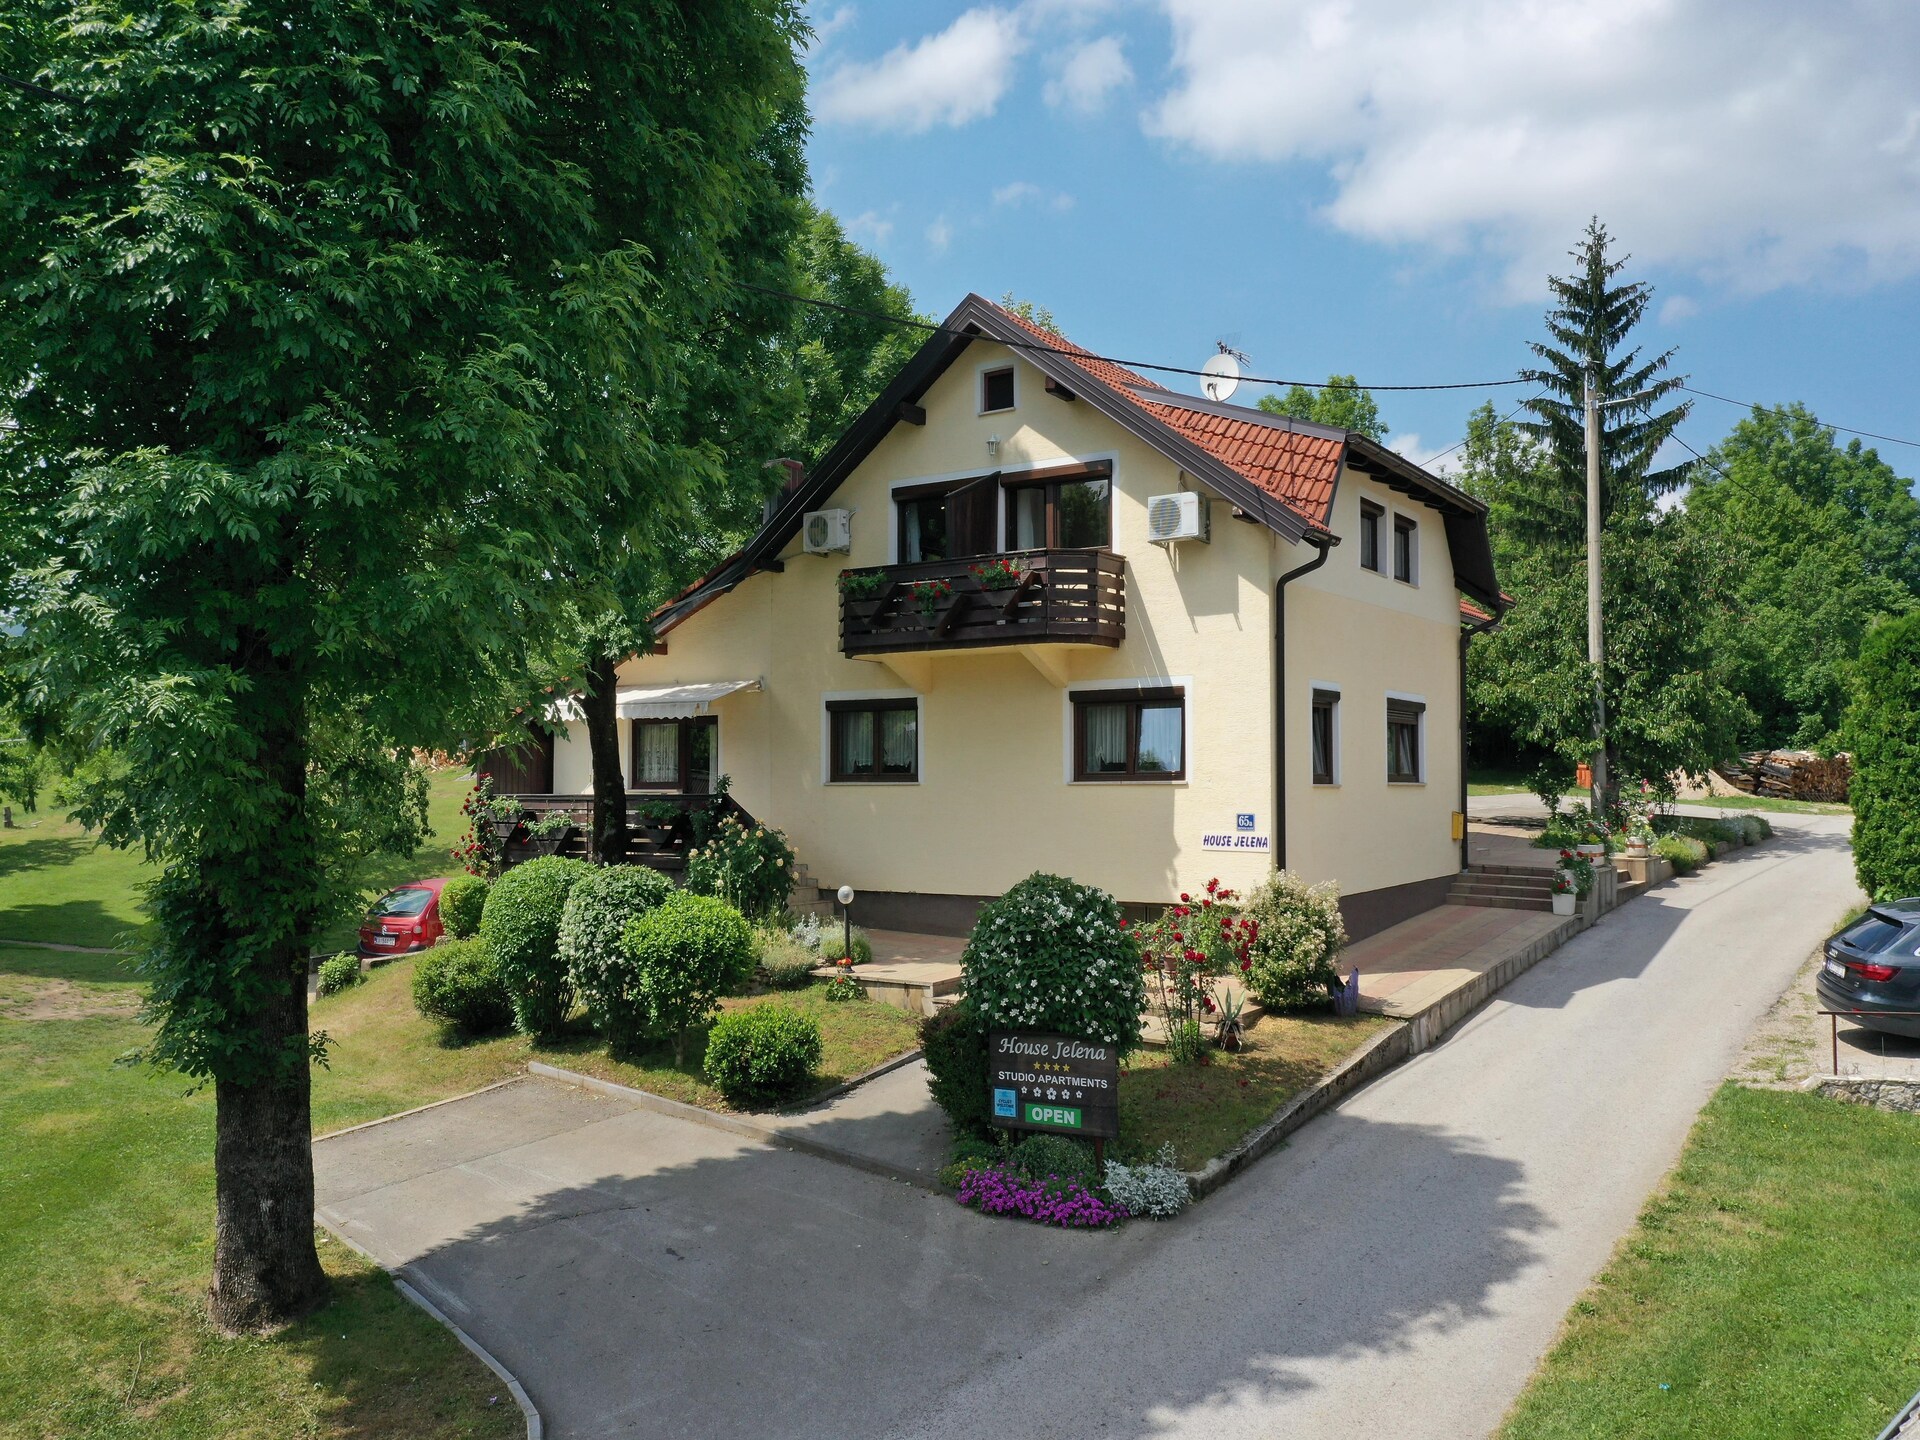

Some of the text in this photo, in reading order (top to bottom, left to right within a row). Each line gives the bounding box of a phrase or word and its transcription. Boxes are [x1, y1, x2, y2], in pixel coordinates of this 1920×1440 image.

[1238, 815, 1253, 827] 65a
[1203, 835, 1268, 848] HOUSE JELENA
[998, 1036, 1107, 1061] House Jelena
[998, 1071, 1108, 1089] STUDIO APARTMENTS
[1031, 1107, 1075, 1125] OPEN
